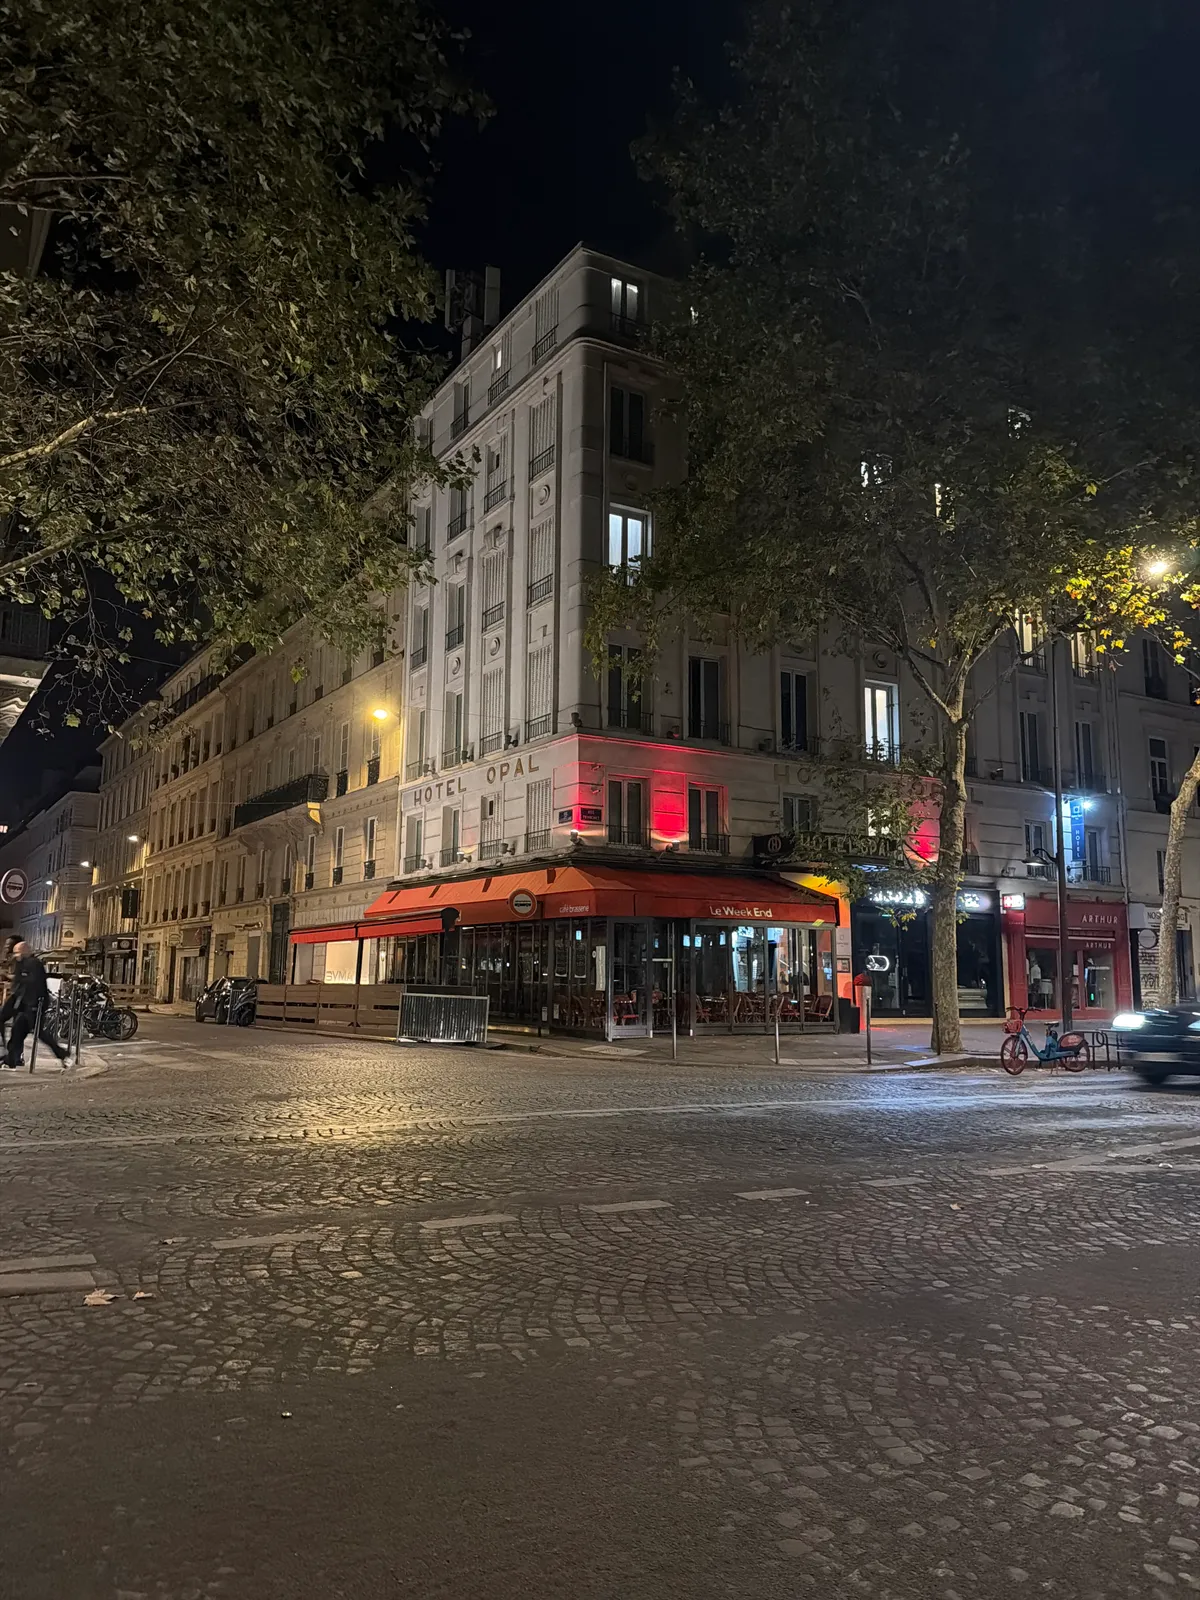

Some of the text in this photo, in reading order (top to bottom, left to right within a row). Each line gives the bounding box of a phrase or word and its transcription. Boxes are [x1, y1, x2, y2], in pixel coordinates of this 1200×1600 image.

[414, 754, 540, 807] HOTEL OPAL
[709, 905, 773, 918] Le Week End
[1081, 914, 1118, 925] ARTHUR
